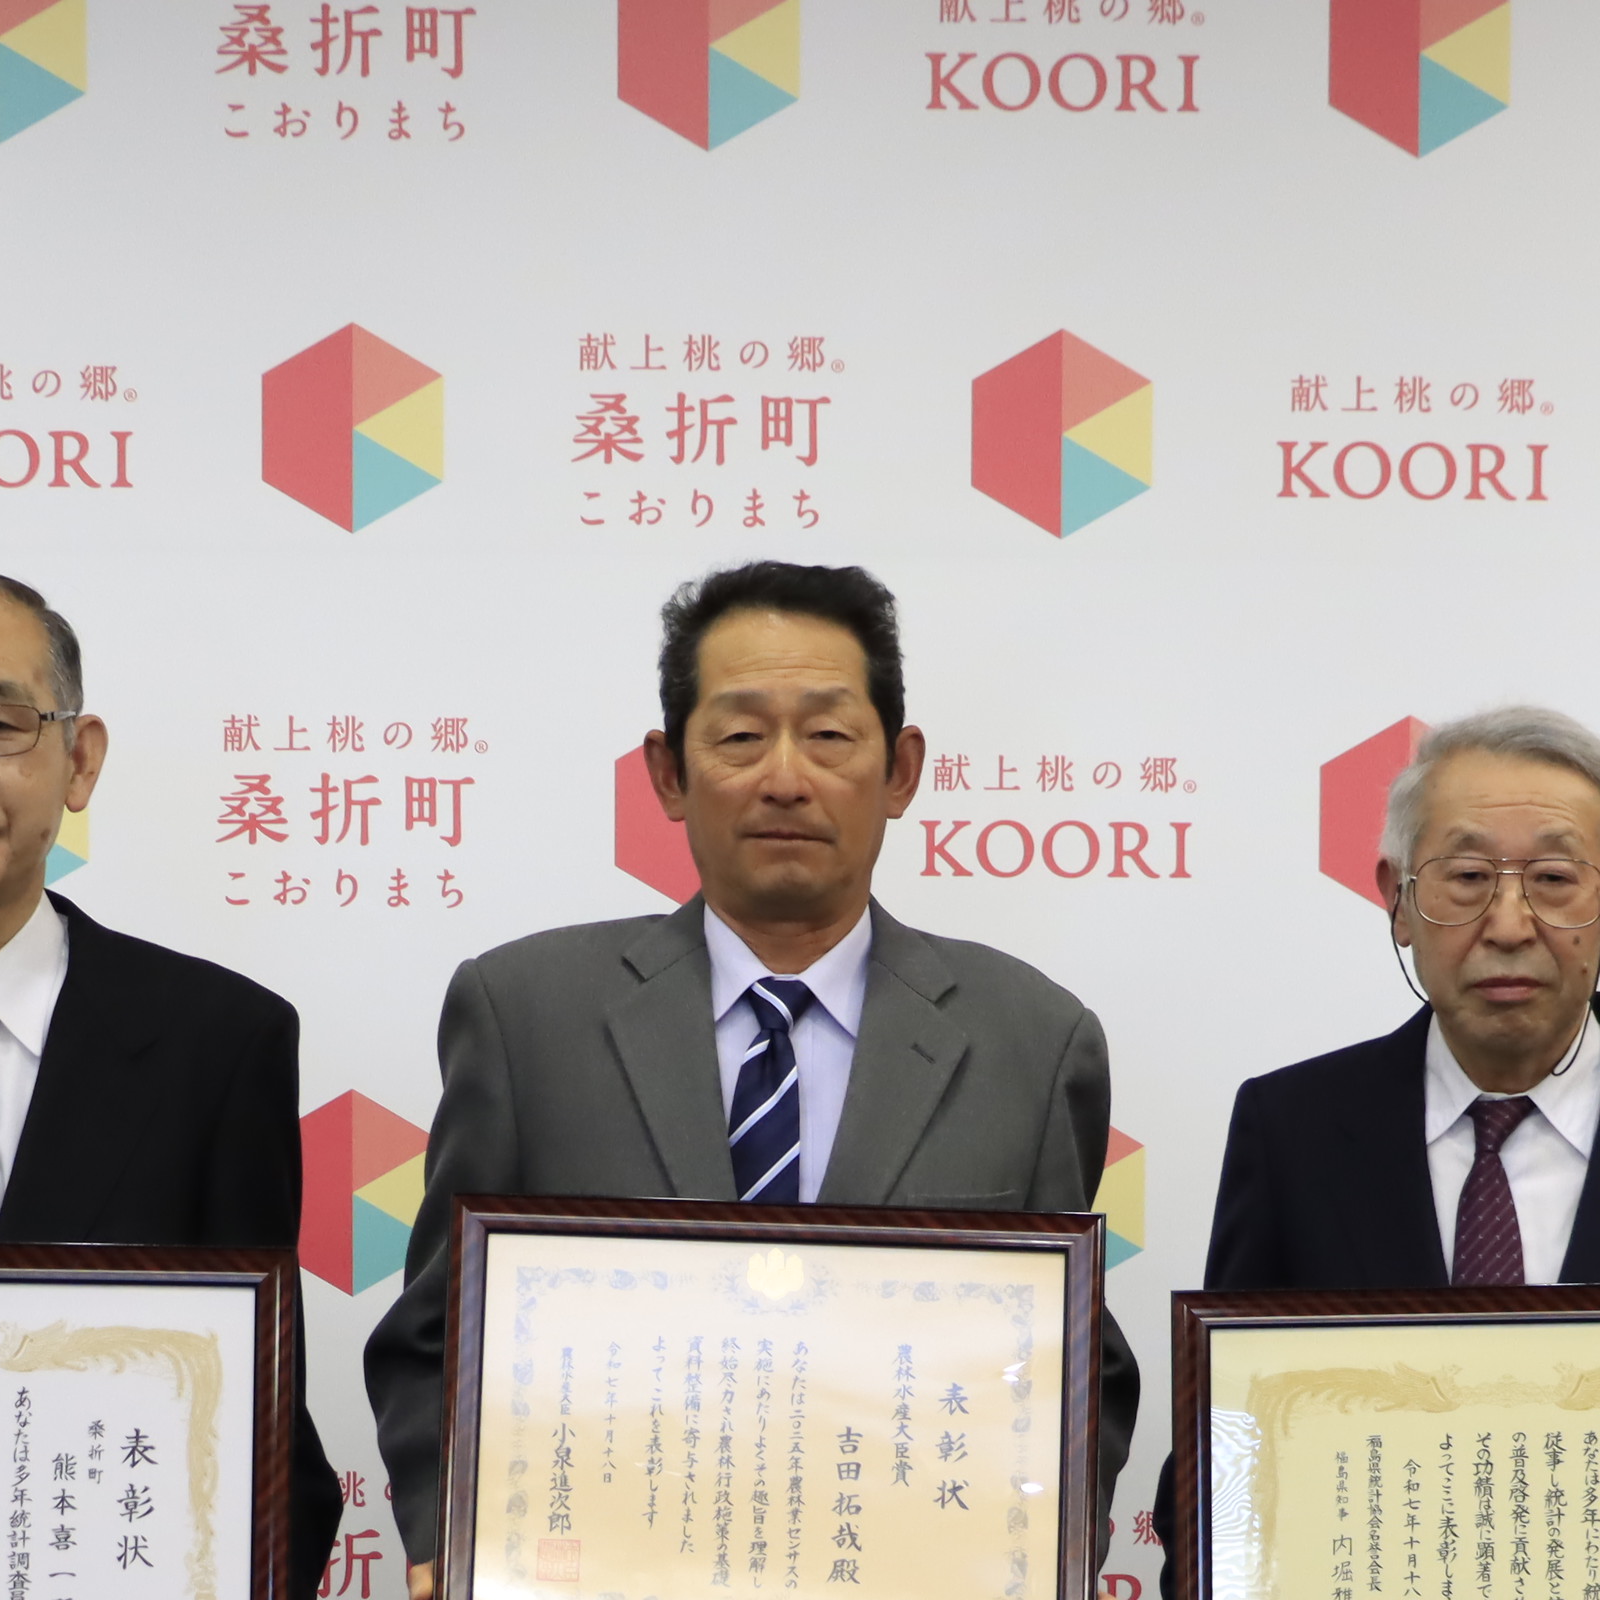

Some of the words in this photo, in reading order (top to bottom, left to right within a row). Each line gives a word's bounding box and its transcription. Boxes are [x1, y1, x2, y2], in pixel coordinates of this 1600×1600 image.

[217, 3, 476, 79] 桑折町
[926, 52, 1200, 112] KOORI
[226, 101, 465, 140] こおりまち
[572, 392, 832, 465] 桑折町
[580, 488, 820, 528] こおりまち
[1277, 441, 1549, 501] KOORI
[216, 772, 476, 846] 桑折町
[920, 819, 1193, 879] KOORI
[226, 868, 464, 908] こおりまち
[602, 1341, 622, 1484] 令和七年十月十八日
[642, 1335, 667, 1529] よってこれを表彰します
[679, 1336, 704, 1554] 資料整備に寄与されました
[891, 1344, 916, 1488] 農林水産大臣賞
[933, 1382, 970, 1511] 表彰状
[87, 1419, 106, 1485] 桑折町
[548, 1423, 575, 1536] 小泉進次郎
[748, 1338, 774, 1589] 実施にあたりよくその趣旨を理解し
[116, 1427, 159, 1571] 表彰状
[826, 1426, 864, 1585] 吉田拓哉殿
